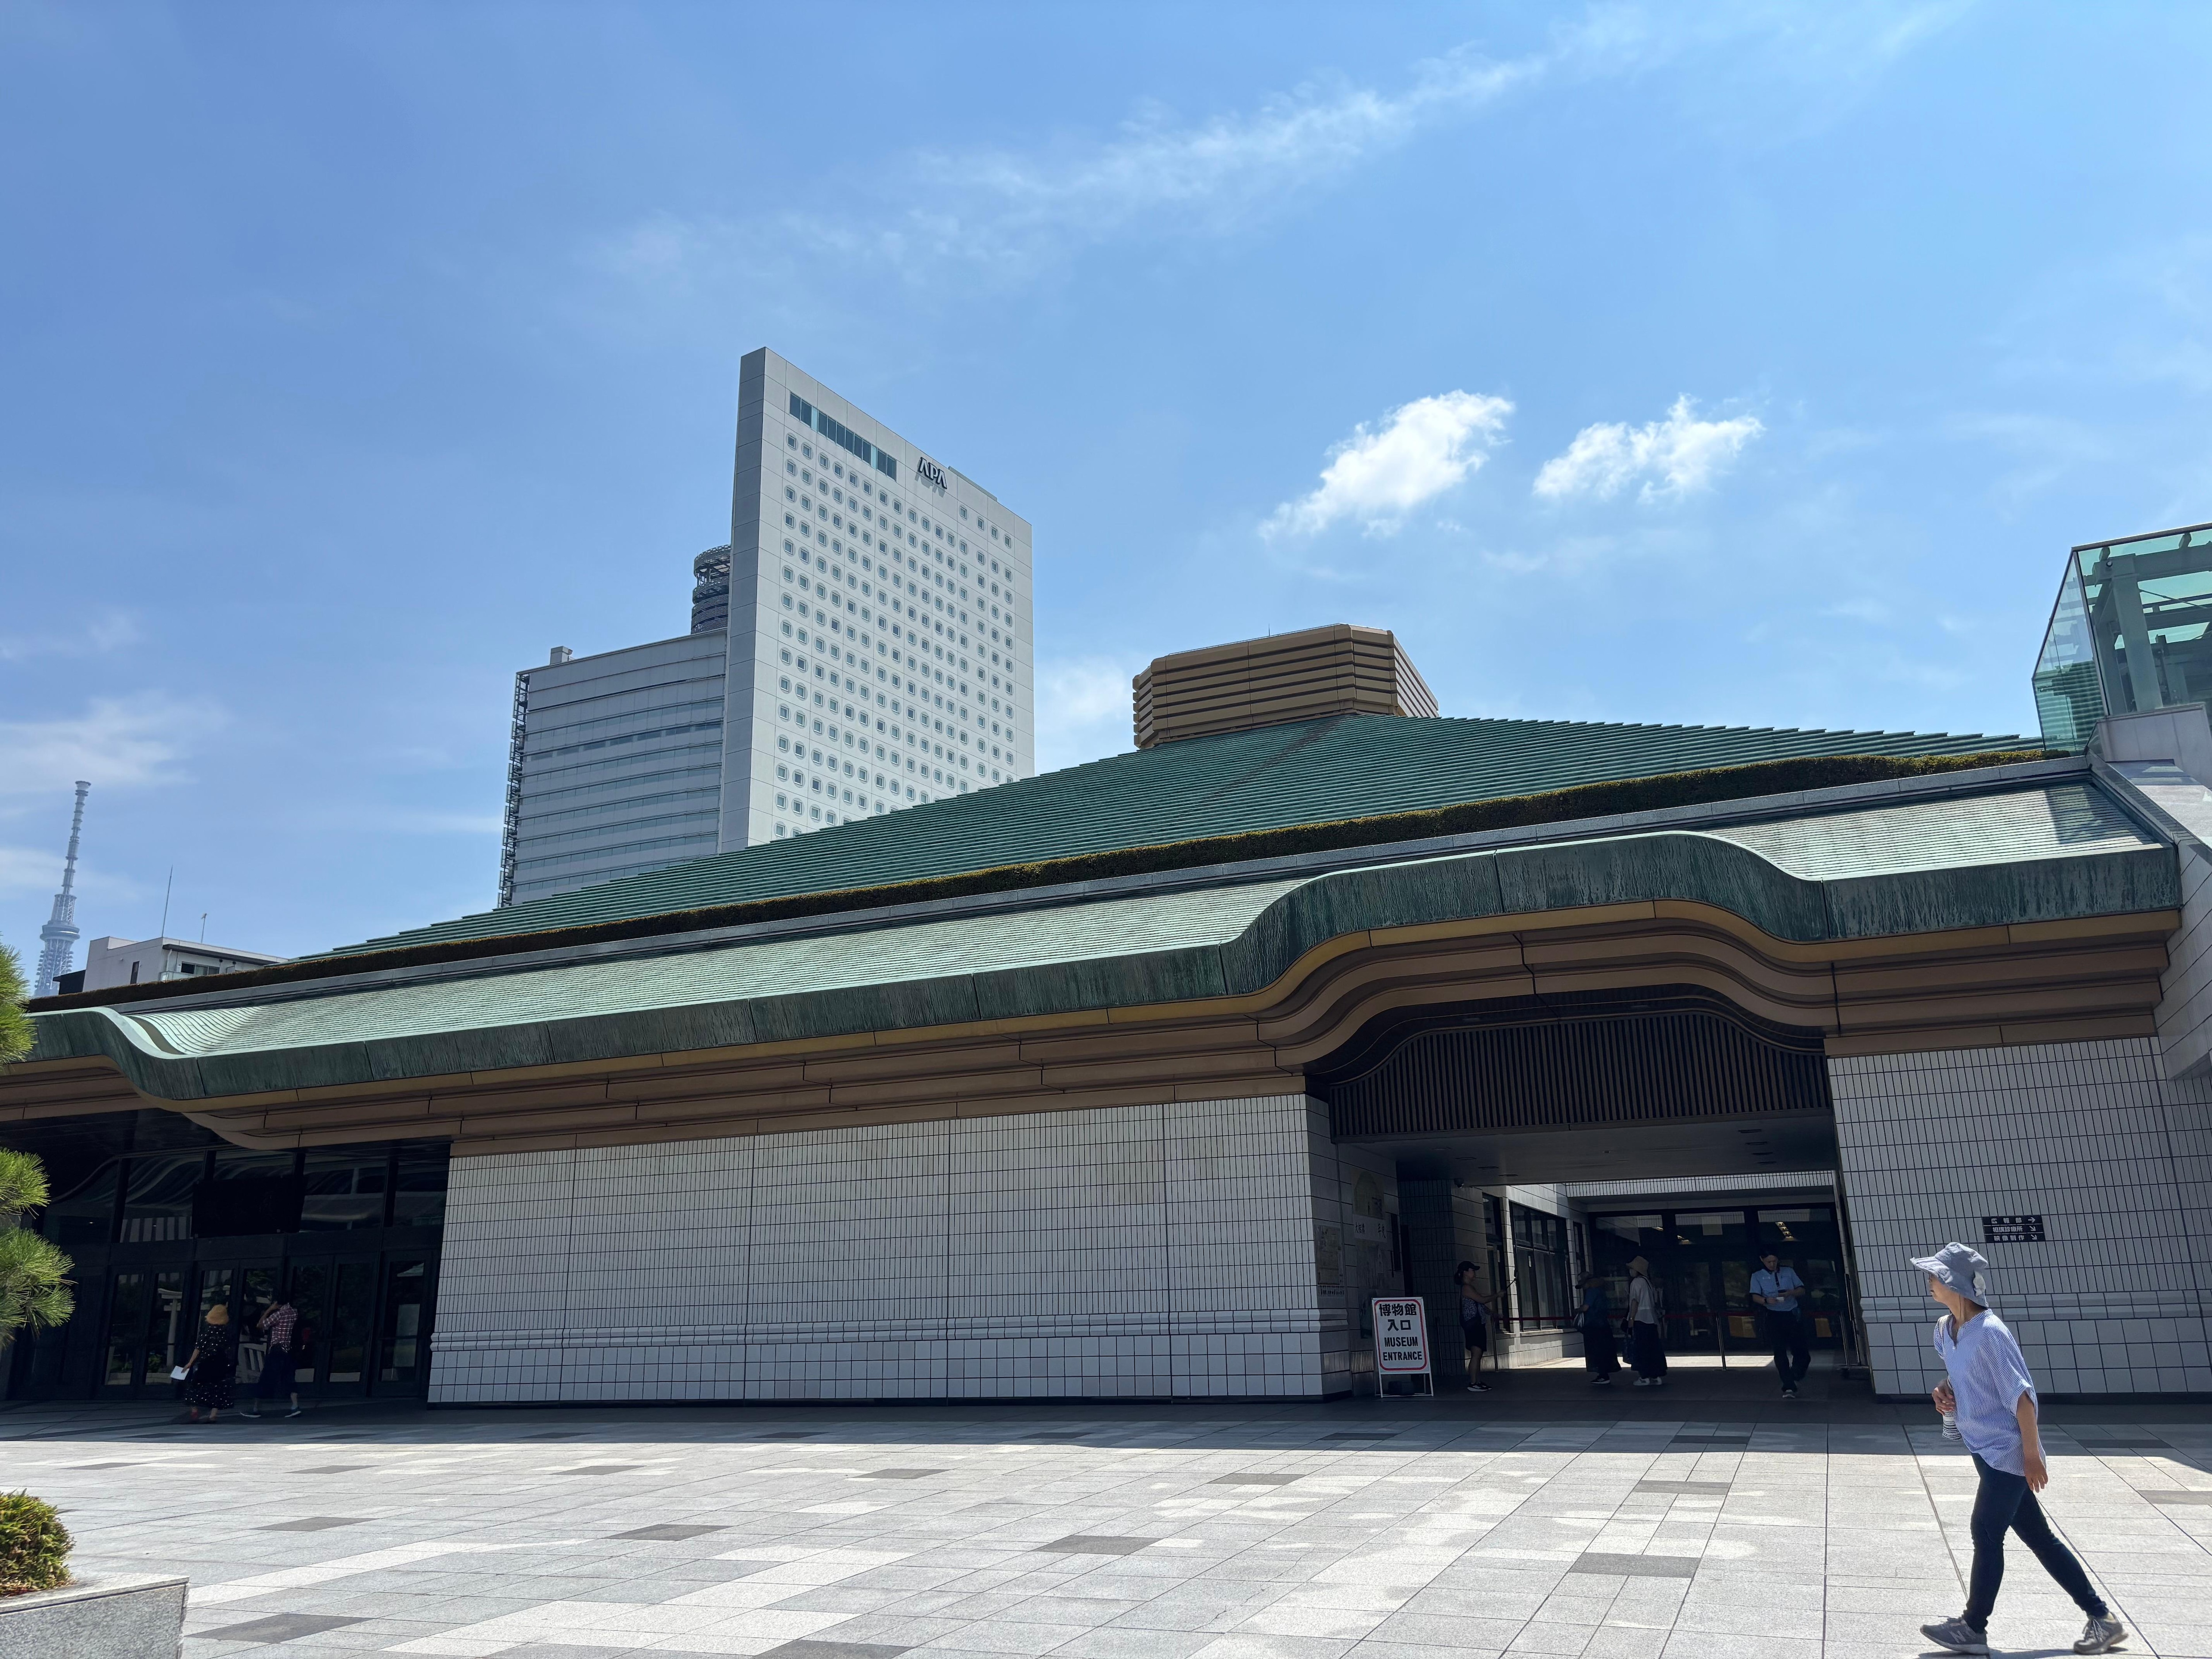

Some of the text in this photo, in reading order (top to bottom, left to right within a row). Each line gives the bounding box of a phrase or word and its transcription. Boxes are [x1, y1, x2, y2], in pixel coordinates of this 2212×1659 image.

[918, 457, 947, 489] APA
[1379, 1303, 1417, 1317] 博物館
[1387, 1319, 1411, 1331] 入口
[1384, 1336, 1418, 1347] MUSEUM
[1383, 1351, 1422, 1361] ENTRANCE
